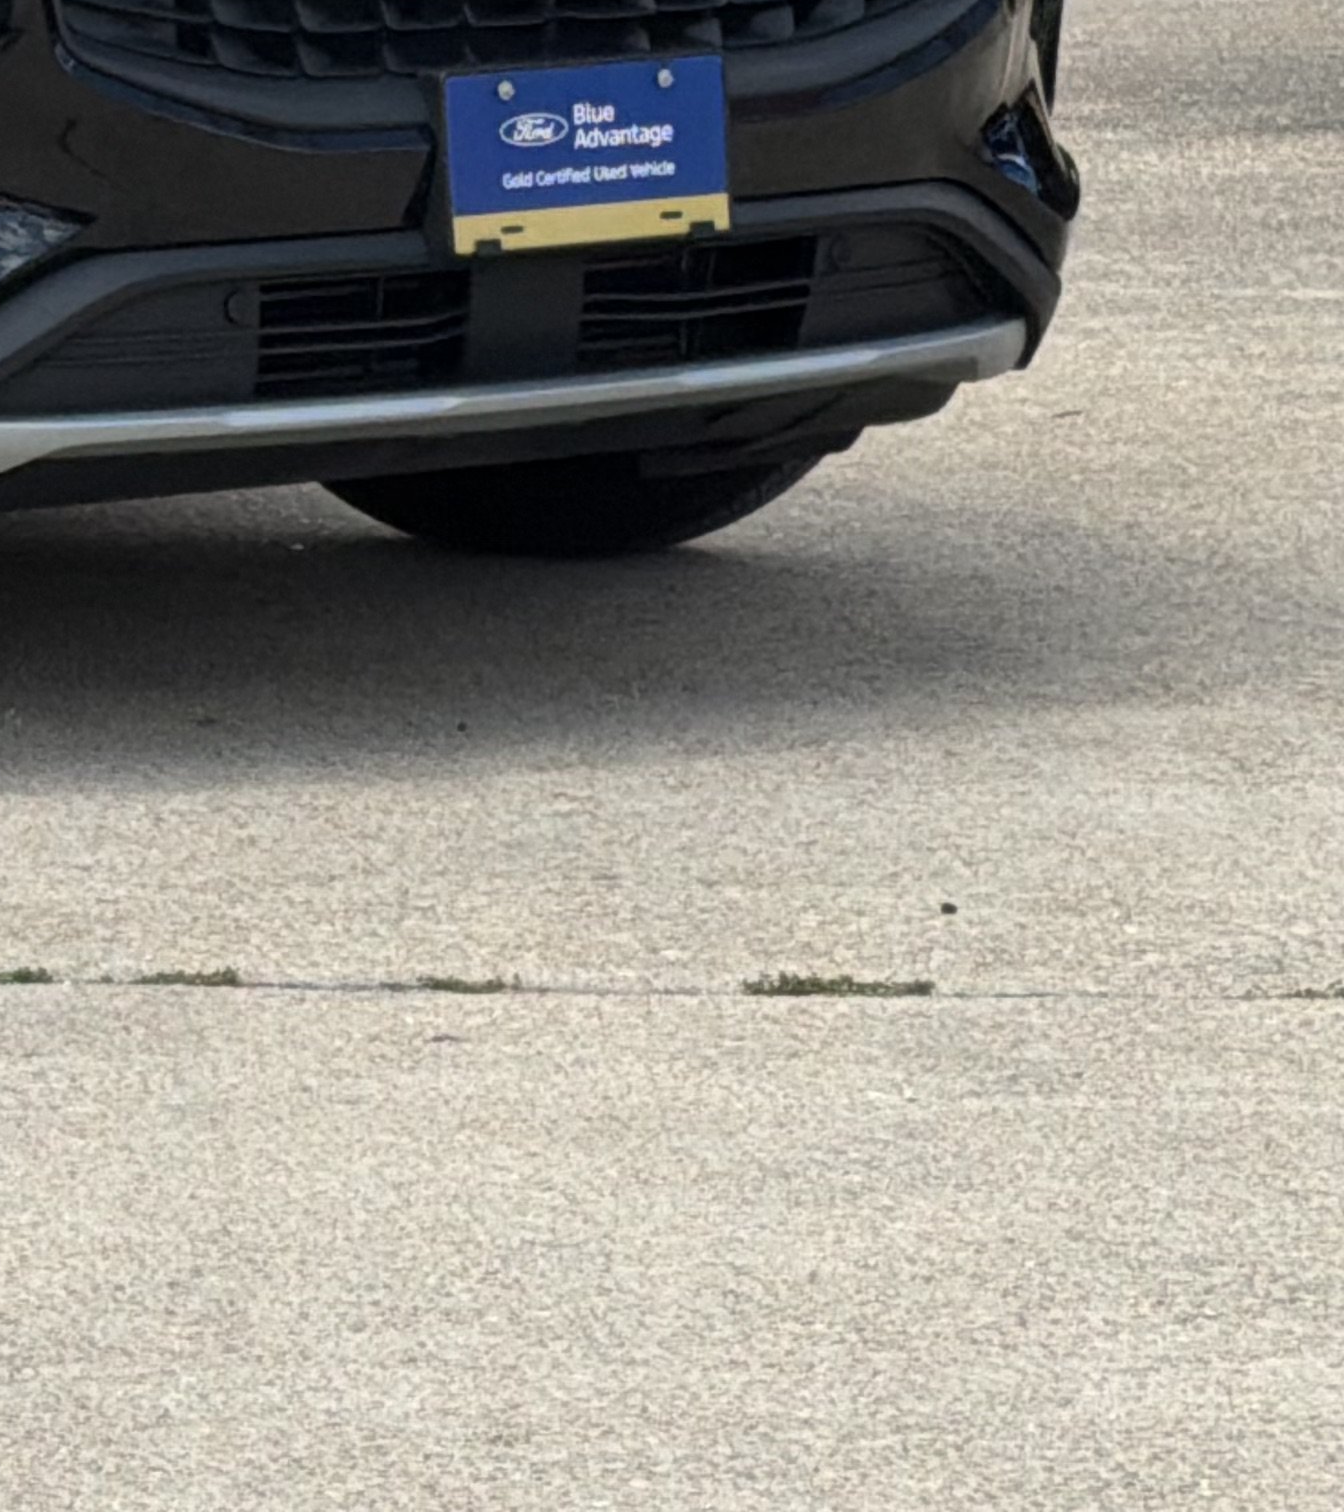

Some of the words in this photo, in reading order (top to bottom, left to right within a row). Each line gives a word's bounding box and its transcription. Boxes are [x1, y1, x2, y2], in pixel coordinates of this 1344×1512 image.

[573, 102, 615, 125] Blue
[514, 118, 555, 142] Ford
[574, 123, 674, 150] Advantage
[502, 171, 533, 190] Gold
[535, 165, 591, 187] Certified
[593, 163, 628, 182] Used
[629, 160, 676, 179] Vehicle
